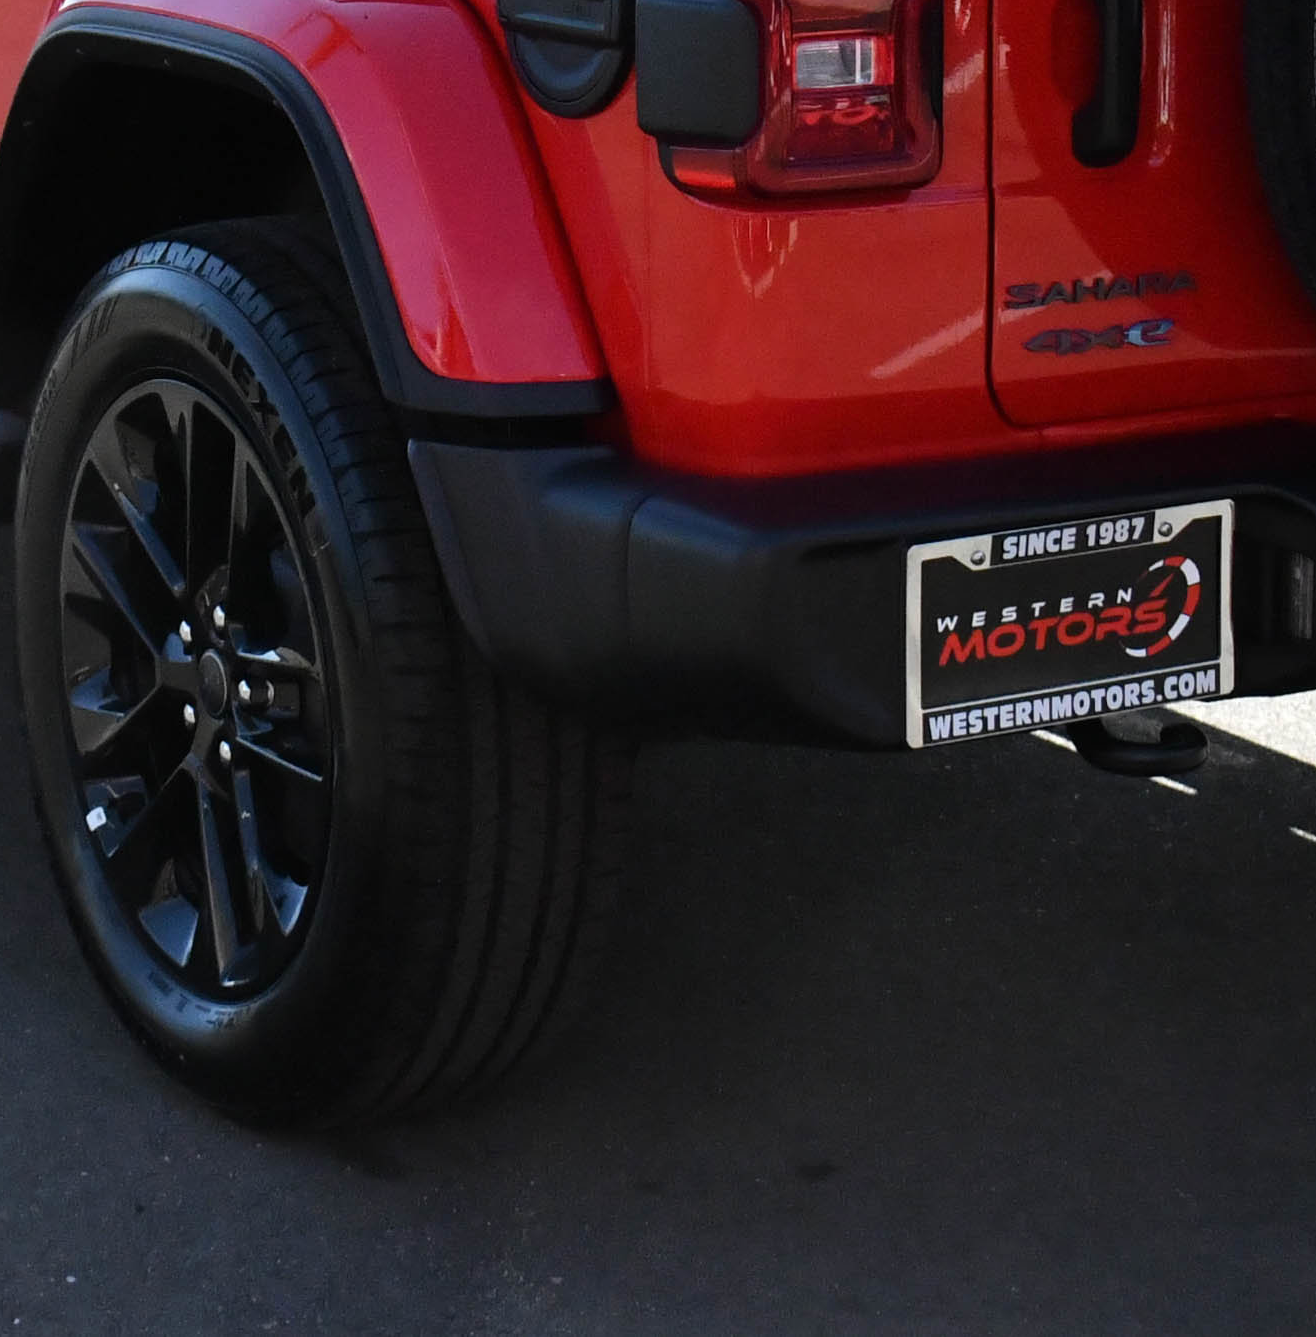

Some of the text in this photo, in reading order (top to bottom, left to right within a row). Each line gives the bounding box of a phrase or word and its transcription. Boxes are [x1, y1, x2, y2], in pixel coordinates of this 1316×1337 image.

[1003, 269, 1198, 310] SAHARA
[207, 326, 316, 521] NEXEN
[1001, 516, 1146, 561] SINCE 1987
[936, 586, 1133, 633] WESTERN
[938, 598, 1169, 667] MOTORS
[928, 668, 1217, 741] WESTERNMOTORS.COM
